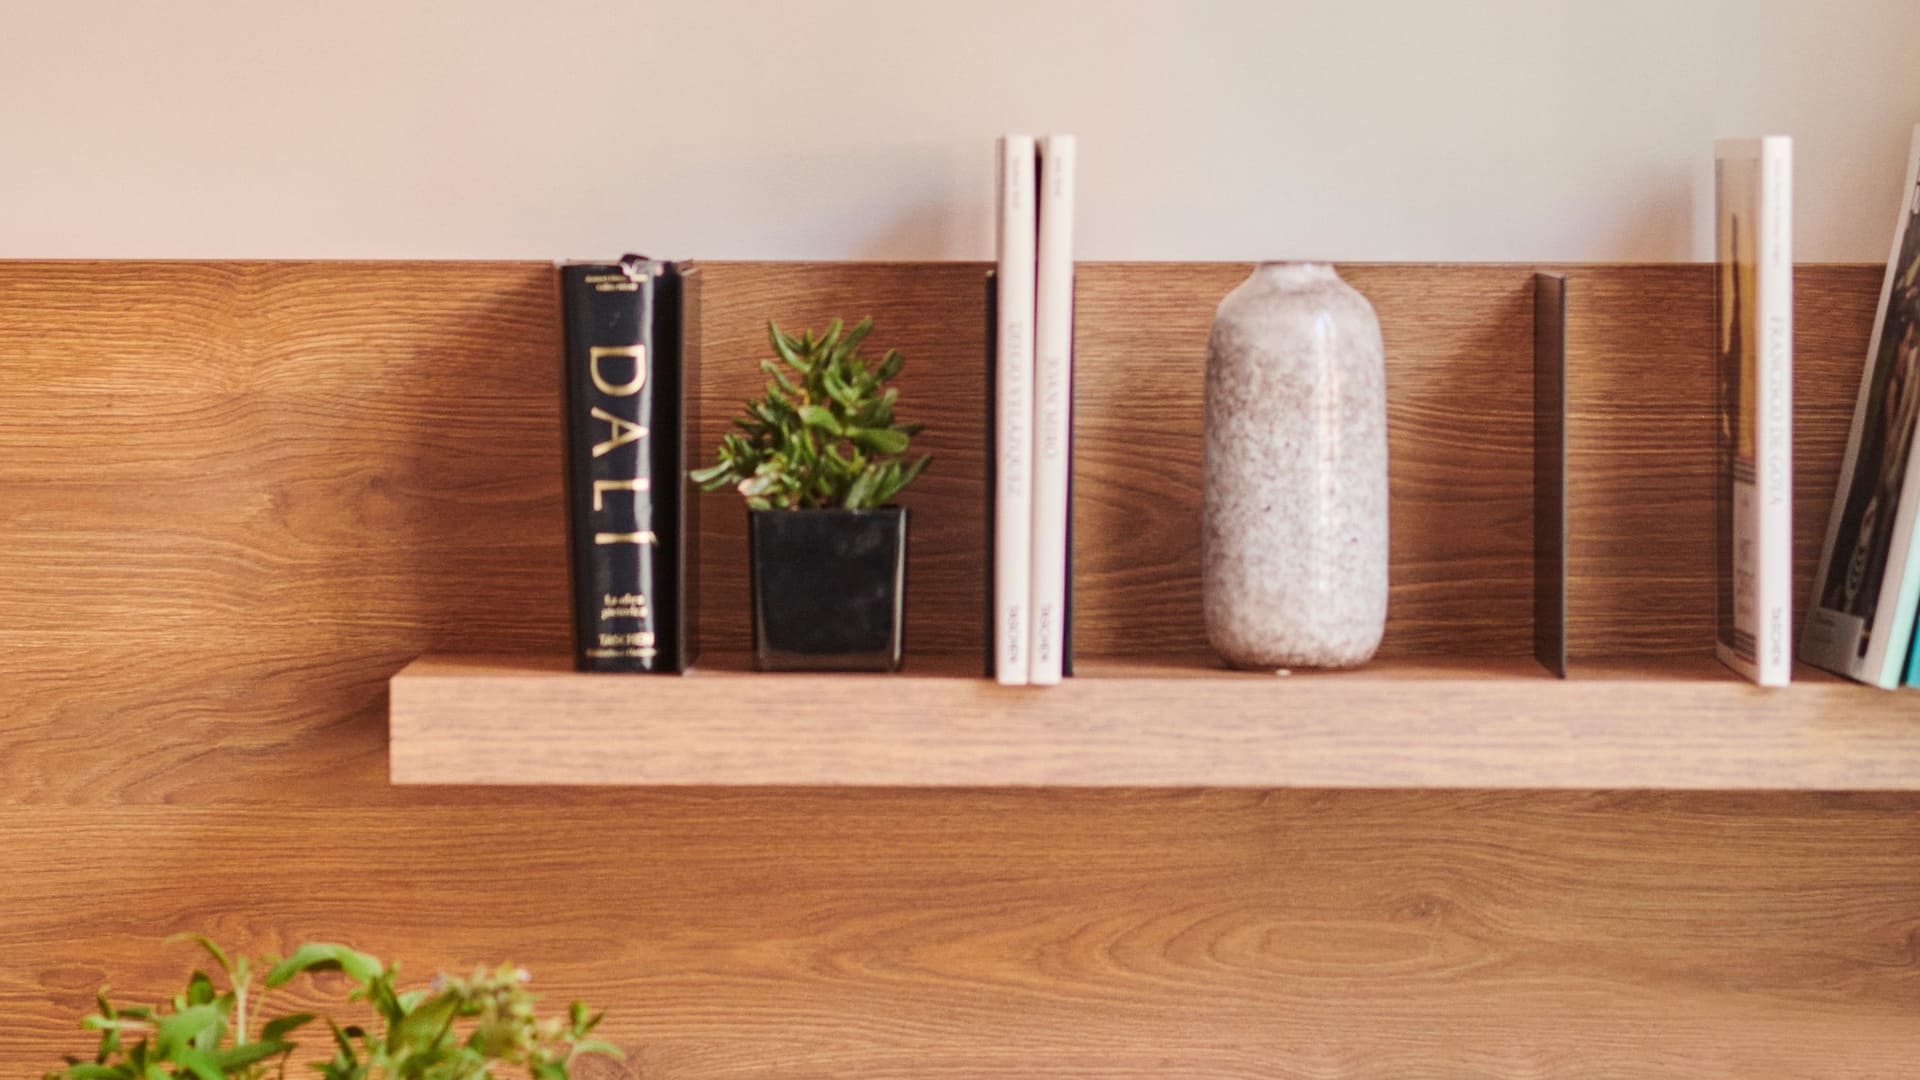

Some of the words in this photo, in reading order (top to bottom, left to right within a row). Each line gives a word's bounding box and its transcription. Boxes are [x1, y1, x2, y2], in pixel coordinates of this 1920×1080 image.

[1007, 320, 1024, 384] DIEGO
[1045, 357, 1061, 404] JOAN
[1768, 315, 1785, 425] FRANCISCO
[590, 344, 659, 545] DALÍ
[1768, 426, 1785, 449] DE
[1768, 455, 1785, 507] GOYA
[1008, 604, 1019, 664] TASCHEN
[1040, 603, 1053, 662] TASCHEN
[1769, 606, 1782, 668] TASCHEN
